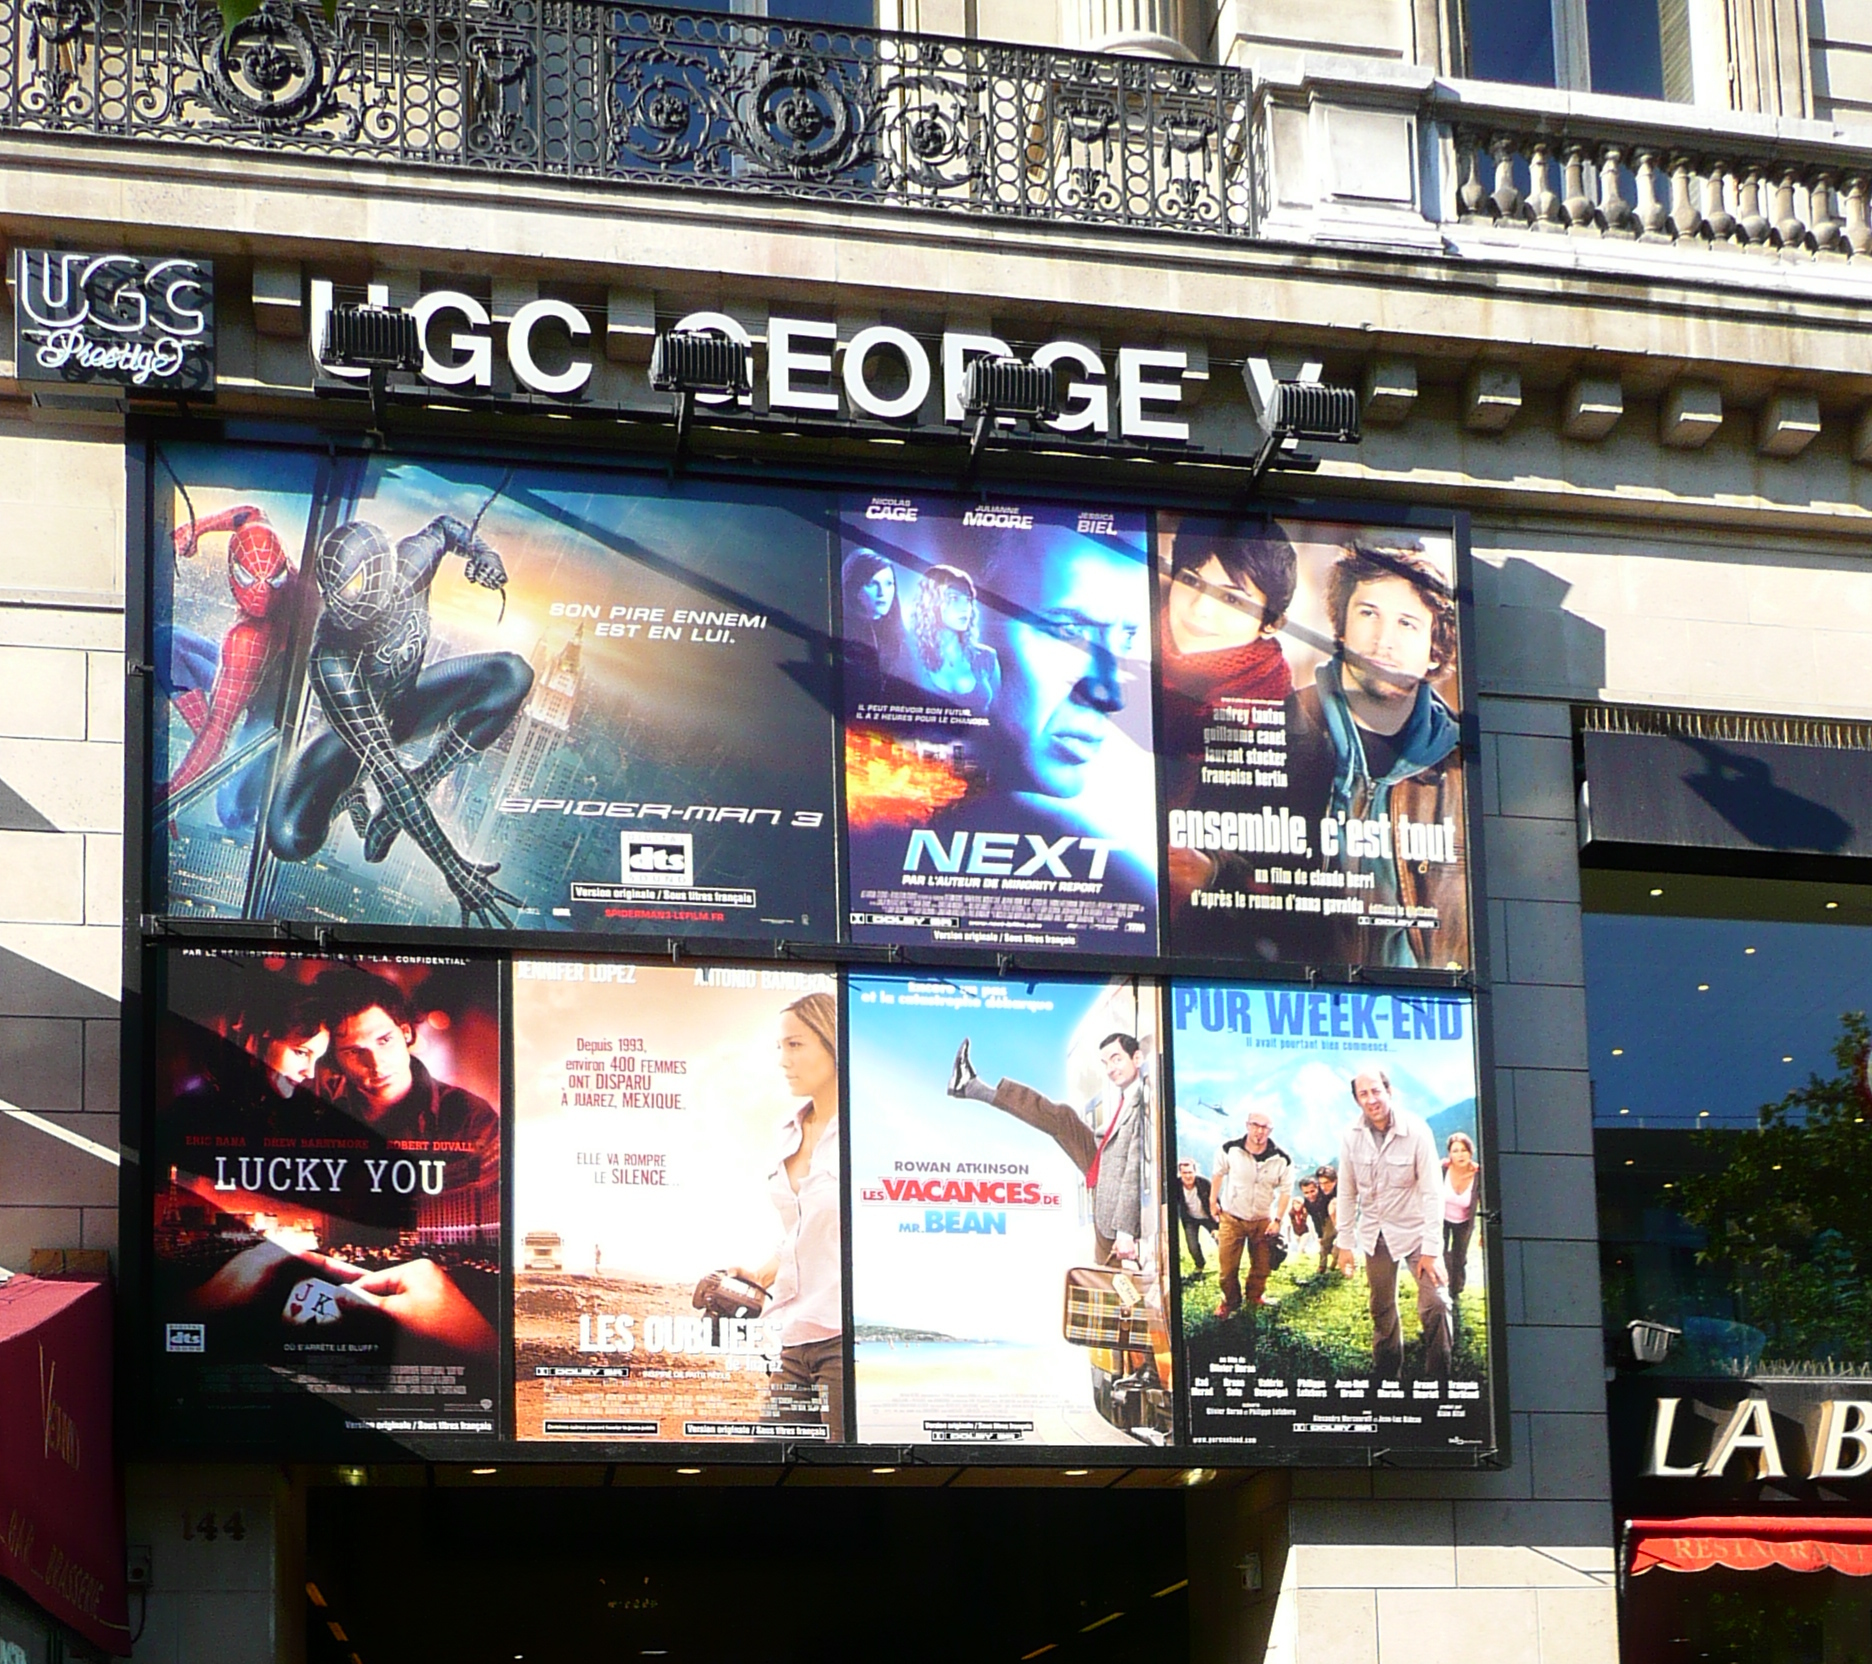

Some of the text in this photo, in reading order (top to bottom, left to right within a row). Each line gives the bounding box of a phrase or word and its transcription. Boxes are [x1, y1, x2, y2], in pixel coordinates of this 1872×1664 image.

[21, 250, 205, 335] UGC
[36, 325, 184, 384] Prestige
[311, 280, 593, 394] UGC
[674, 312, 1190, 440] GEORGE
[871, 497, 1114, 521] NICOLAS JULIANNE JESSICA
[866, 506, 1117, 535] CAGE MOORE BIEL
[549, 603, 768, 629] SON PIRE ENNEMI
[595, 622, 736, 644] EST EN LUI.
[867, 704, 888, 712] PEUT
[1213, 706, 1250, 725] audrey
[1203, 726, 1254, 743] guillaume
[1205, 746, 1244, 764] laurent
[498, 798, 824, 827] SPIDER-MAN 3
[1169, 806, 1458, 863] ensemble, c'est tout
[629, 846, 685, 872] dts
[903, 829, 1122, 880] NEXT
[902, 874, 1104, 894] PAR L'AUTEUR DE MINORITY REPORT
[1270, 867, 1292, 884] film
[1294, 868, 1309, 886] de
[1310, 869, 1345, 888] claude
[575, 886, 611, 898] Version
[613, 888, 656, 901] originale
[663, 888, 687, 901] Sous
[182, 949, 202, 957] PAR
[517, 962, 585, 981] JENNIFER
[589, 964, 636, 983] LOPEZ
[693, 968, 757, 988] ANTONIO
[1176, 989, 1463, 1041] PUR WEEK-END
[577, 1037, 647, 1055] Depuis 1993,
[1256, 1038, 1277, 1048] avait
[1280, 1039, 1318, 1049] pourtant
[1322, 1040, 1339, 1050] bien
[565, 1057, 687, 1075] environ 400 FEMMES
[568, 1074, 651, 1091] ONT DISPARU
[561, 1087, 568, 1106] À
[185, 1135, 247, 1147] ERIC BANA
[263, 1137, 370, 1150] DREW BARRYMORE
[386, 1139, 475, 1152] ROBERT DUVALL
[577, 1152, 666, 1168] ELLE VA ROMPRE
[894, 1161, 1029, 1175] ROWAN ATKINSON
[214, 1156, 446, 1195] LUCKY YOU
[594, 1171, 606, 1184] LE
[862, 1177, 1060, 1206] LES VACANCES DE
[899, 1210, 1006, 1235] MR. BEAN
[294, 1283, 333, 1316] J K
[170, 1331, 201, 1344] dts
[578, 1307, 784, 1360] LES OUBLIÉES
[1655, 1397, 1787, 1478] LA
[181, 1511, 245, 1541] 144
